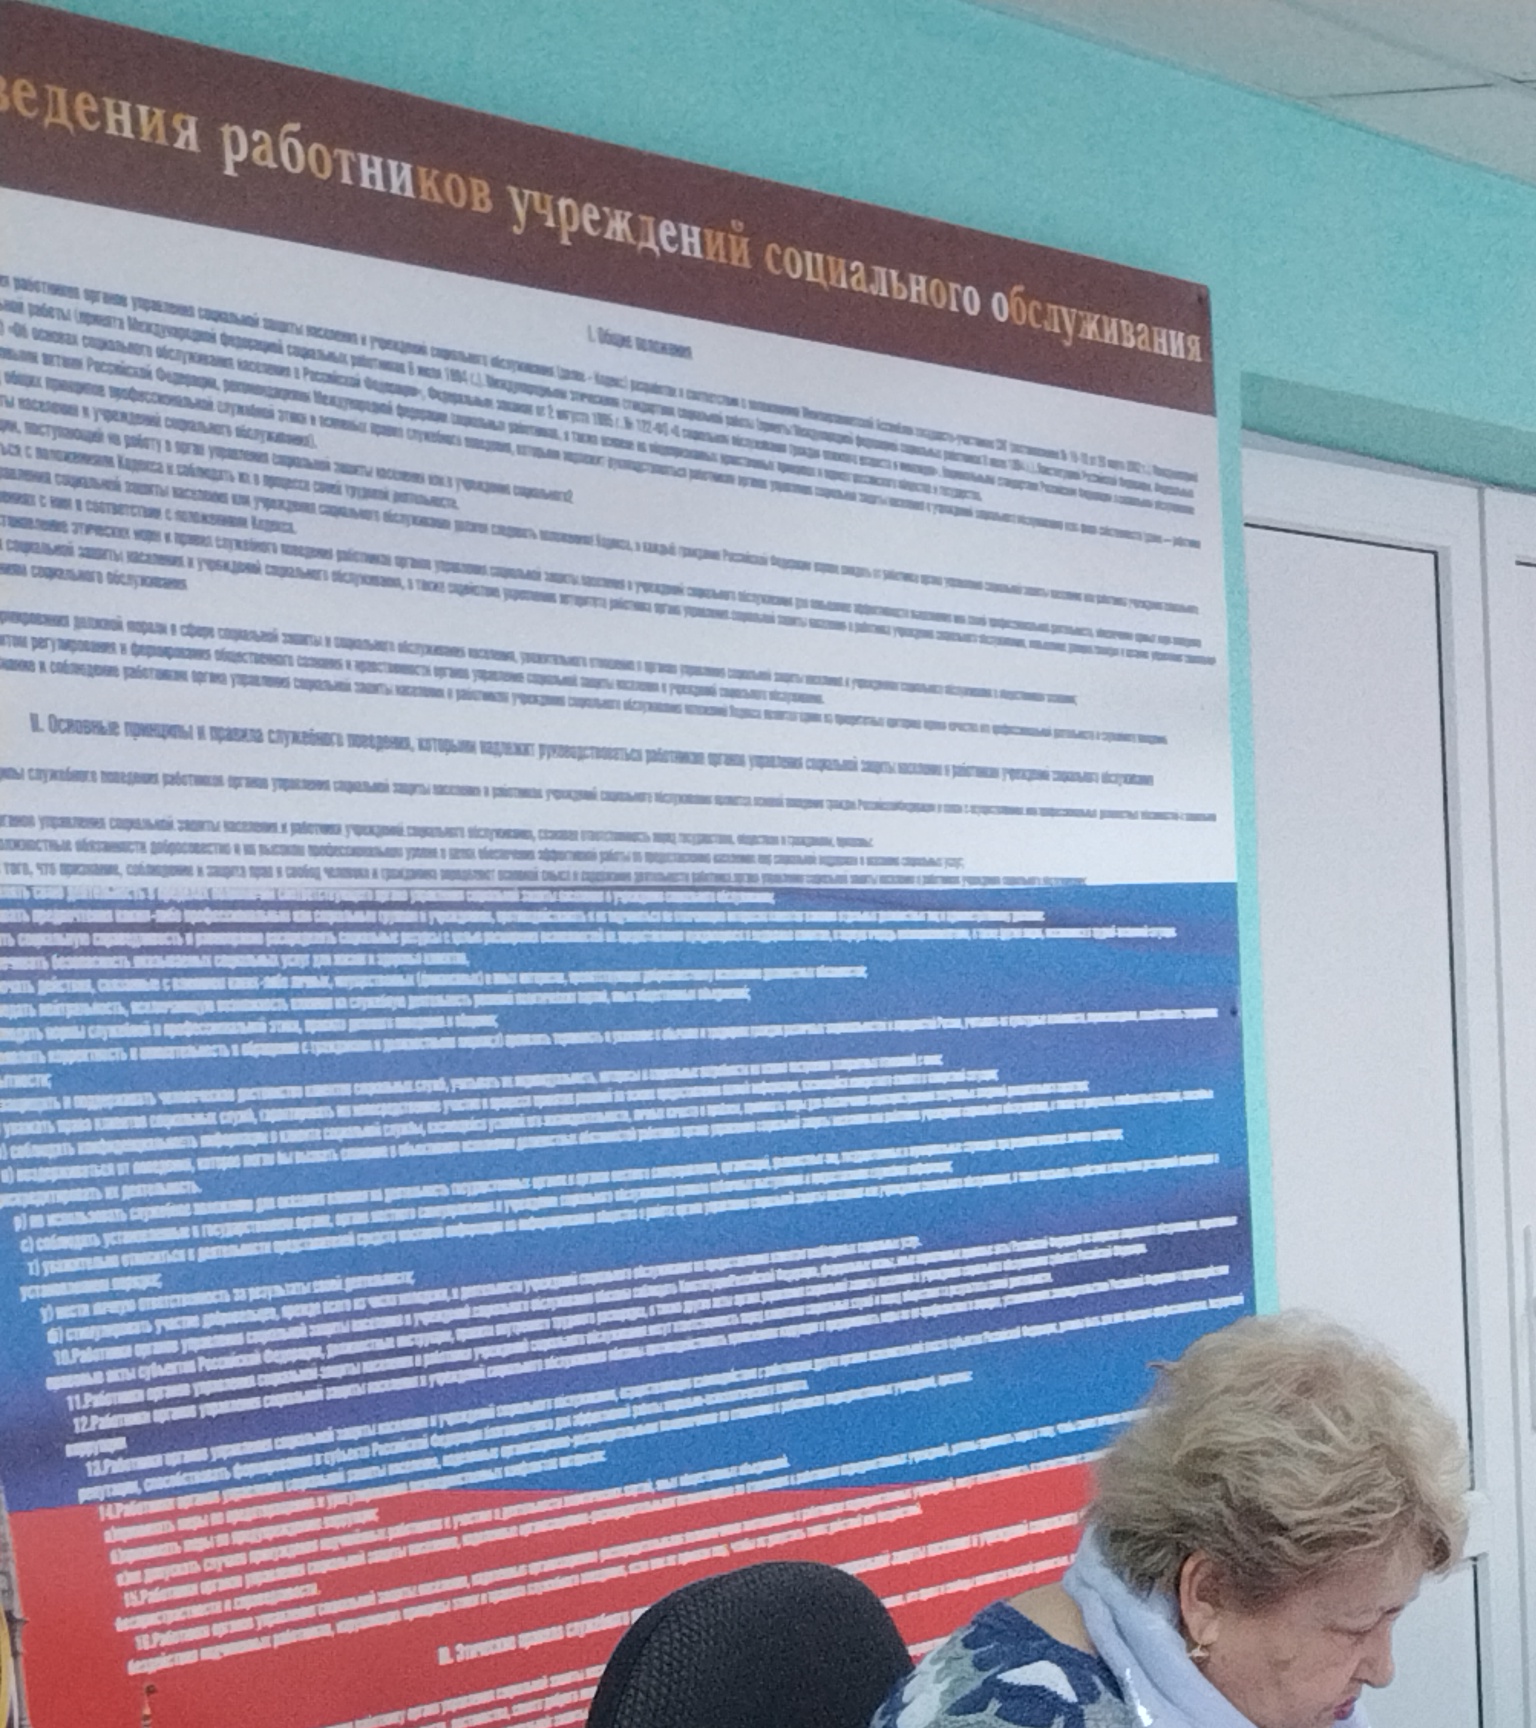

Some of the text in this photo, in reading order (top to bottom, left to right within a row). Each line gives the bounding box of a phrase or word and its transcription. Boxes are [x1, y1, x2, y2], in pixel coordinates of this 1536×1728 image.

[220, 120, 494, 214] работников
[507, 183, 752, 270] учреждений
[765, 237, 981, 318] социального
[991, 283, 1203, 363] обслуживания
